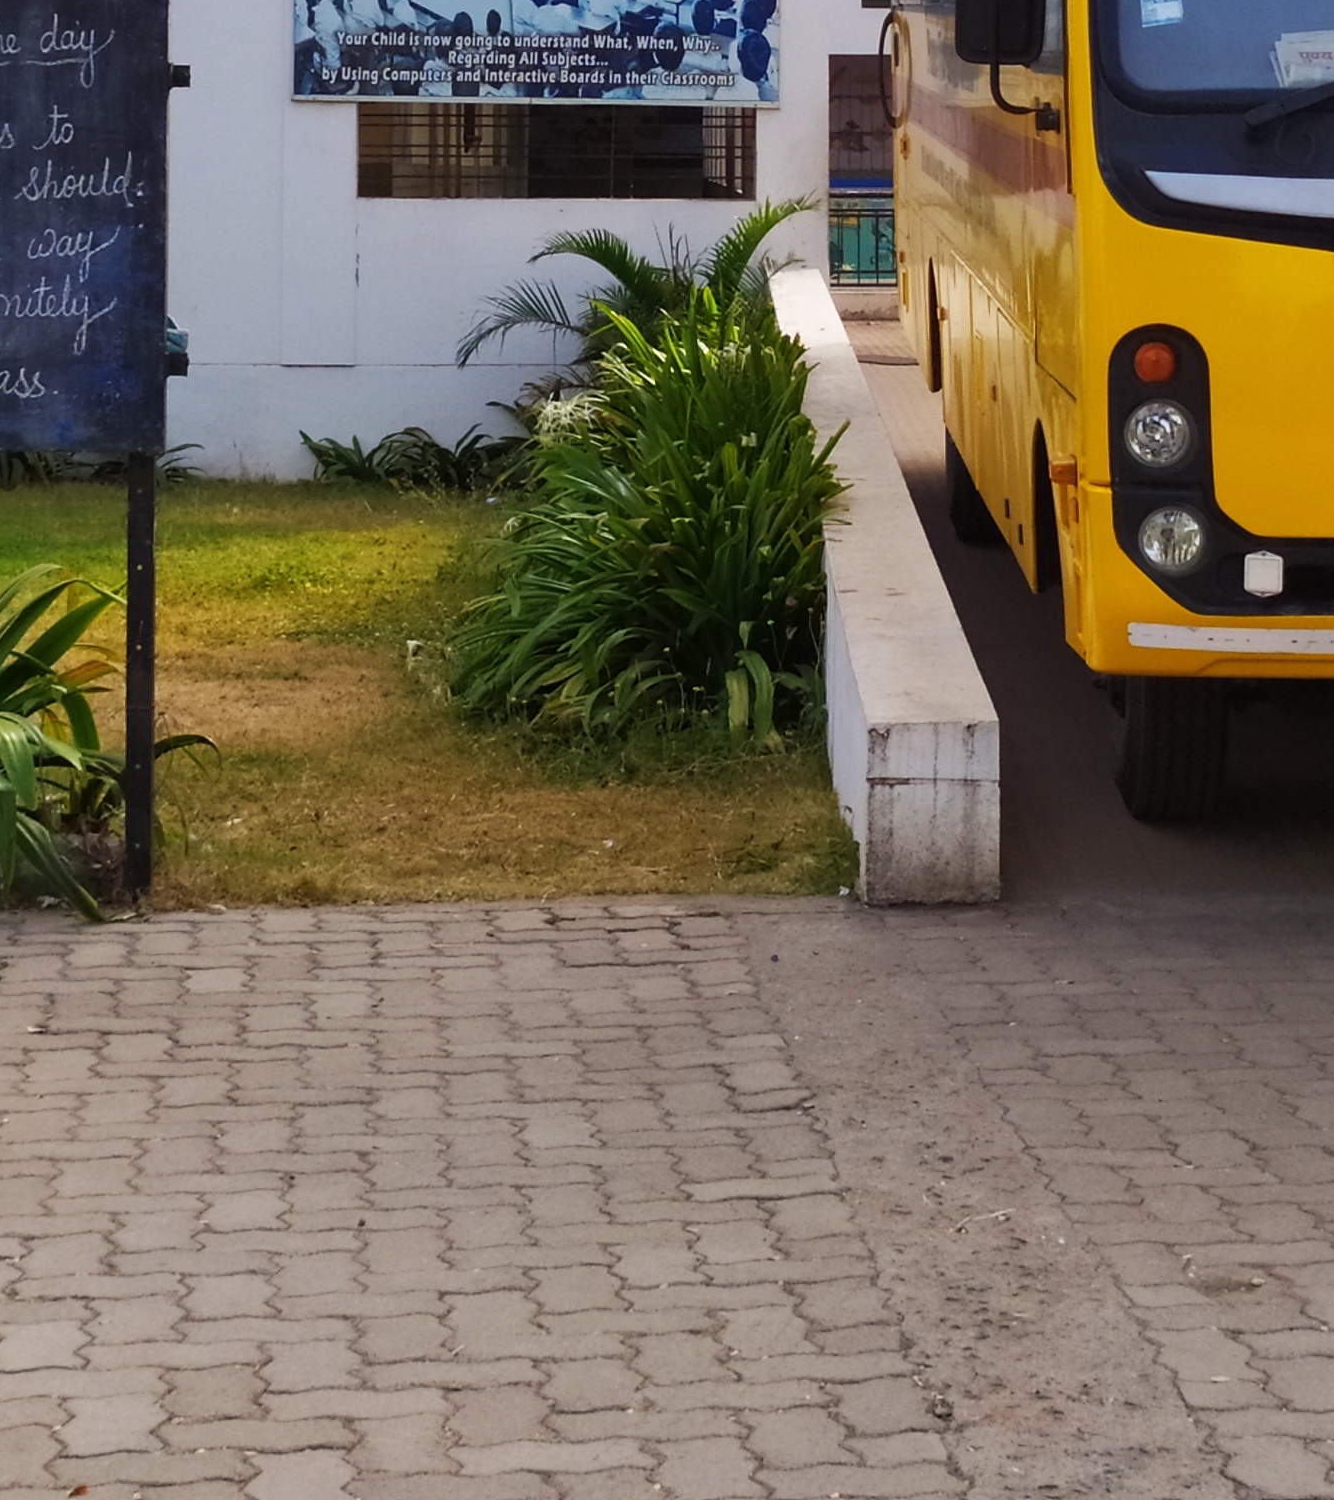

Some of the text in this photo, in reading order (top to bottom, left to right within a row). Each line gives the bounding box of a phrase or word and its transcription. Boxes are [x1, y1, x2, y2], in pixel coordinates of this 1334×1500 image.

[40, 13, 114, 88] day
[337, 31, 368, 46] Your
[371, 32, 406, 46] Child
[409, 32, 420, 46] is
[424, 35, 451, 46] now
[455, 33, 493, 50] going
[497, 35, 511, 47] to
[515, 35, 589, 48] understand
[594, 35, 632, 51] What,
[636, 36, 678, 51] When,
[448, 51, 609, 68] Regarding All Subjects...
[322, 67, 734, 86] by Using Computers and Interactive Boards in their Classrooms
[33, 105, 74, 151] to
[27, 226, 120, 283] way
